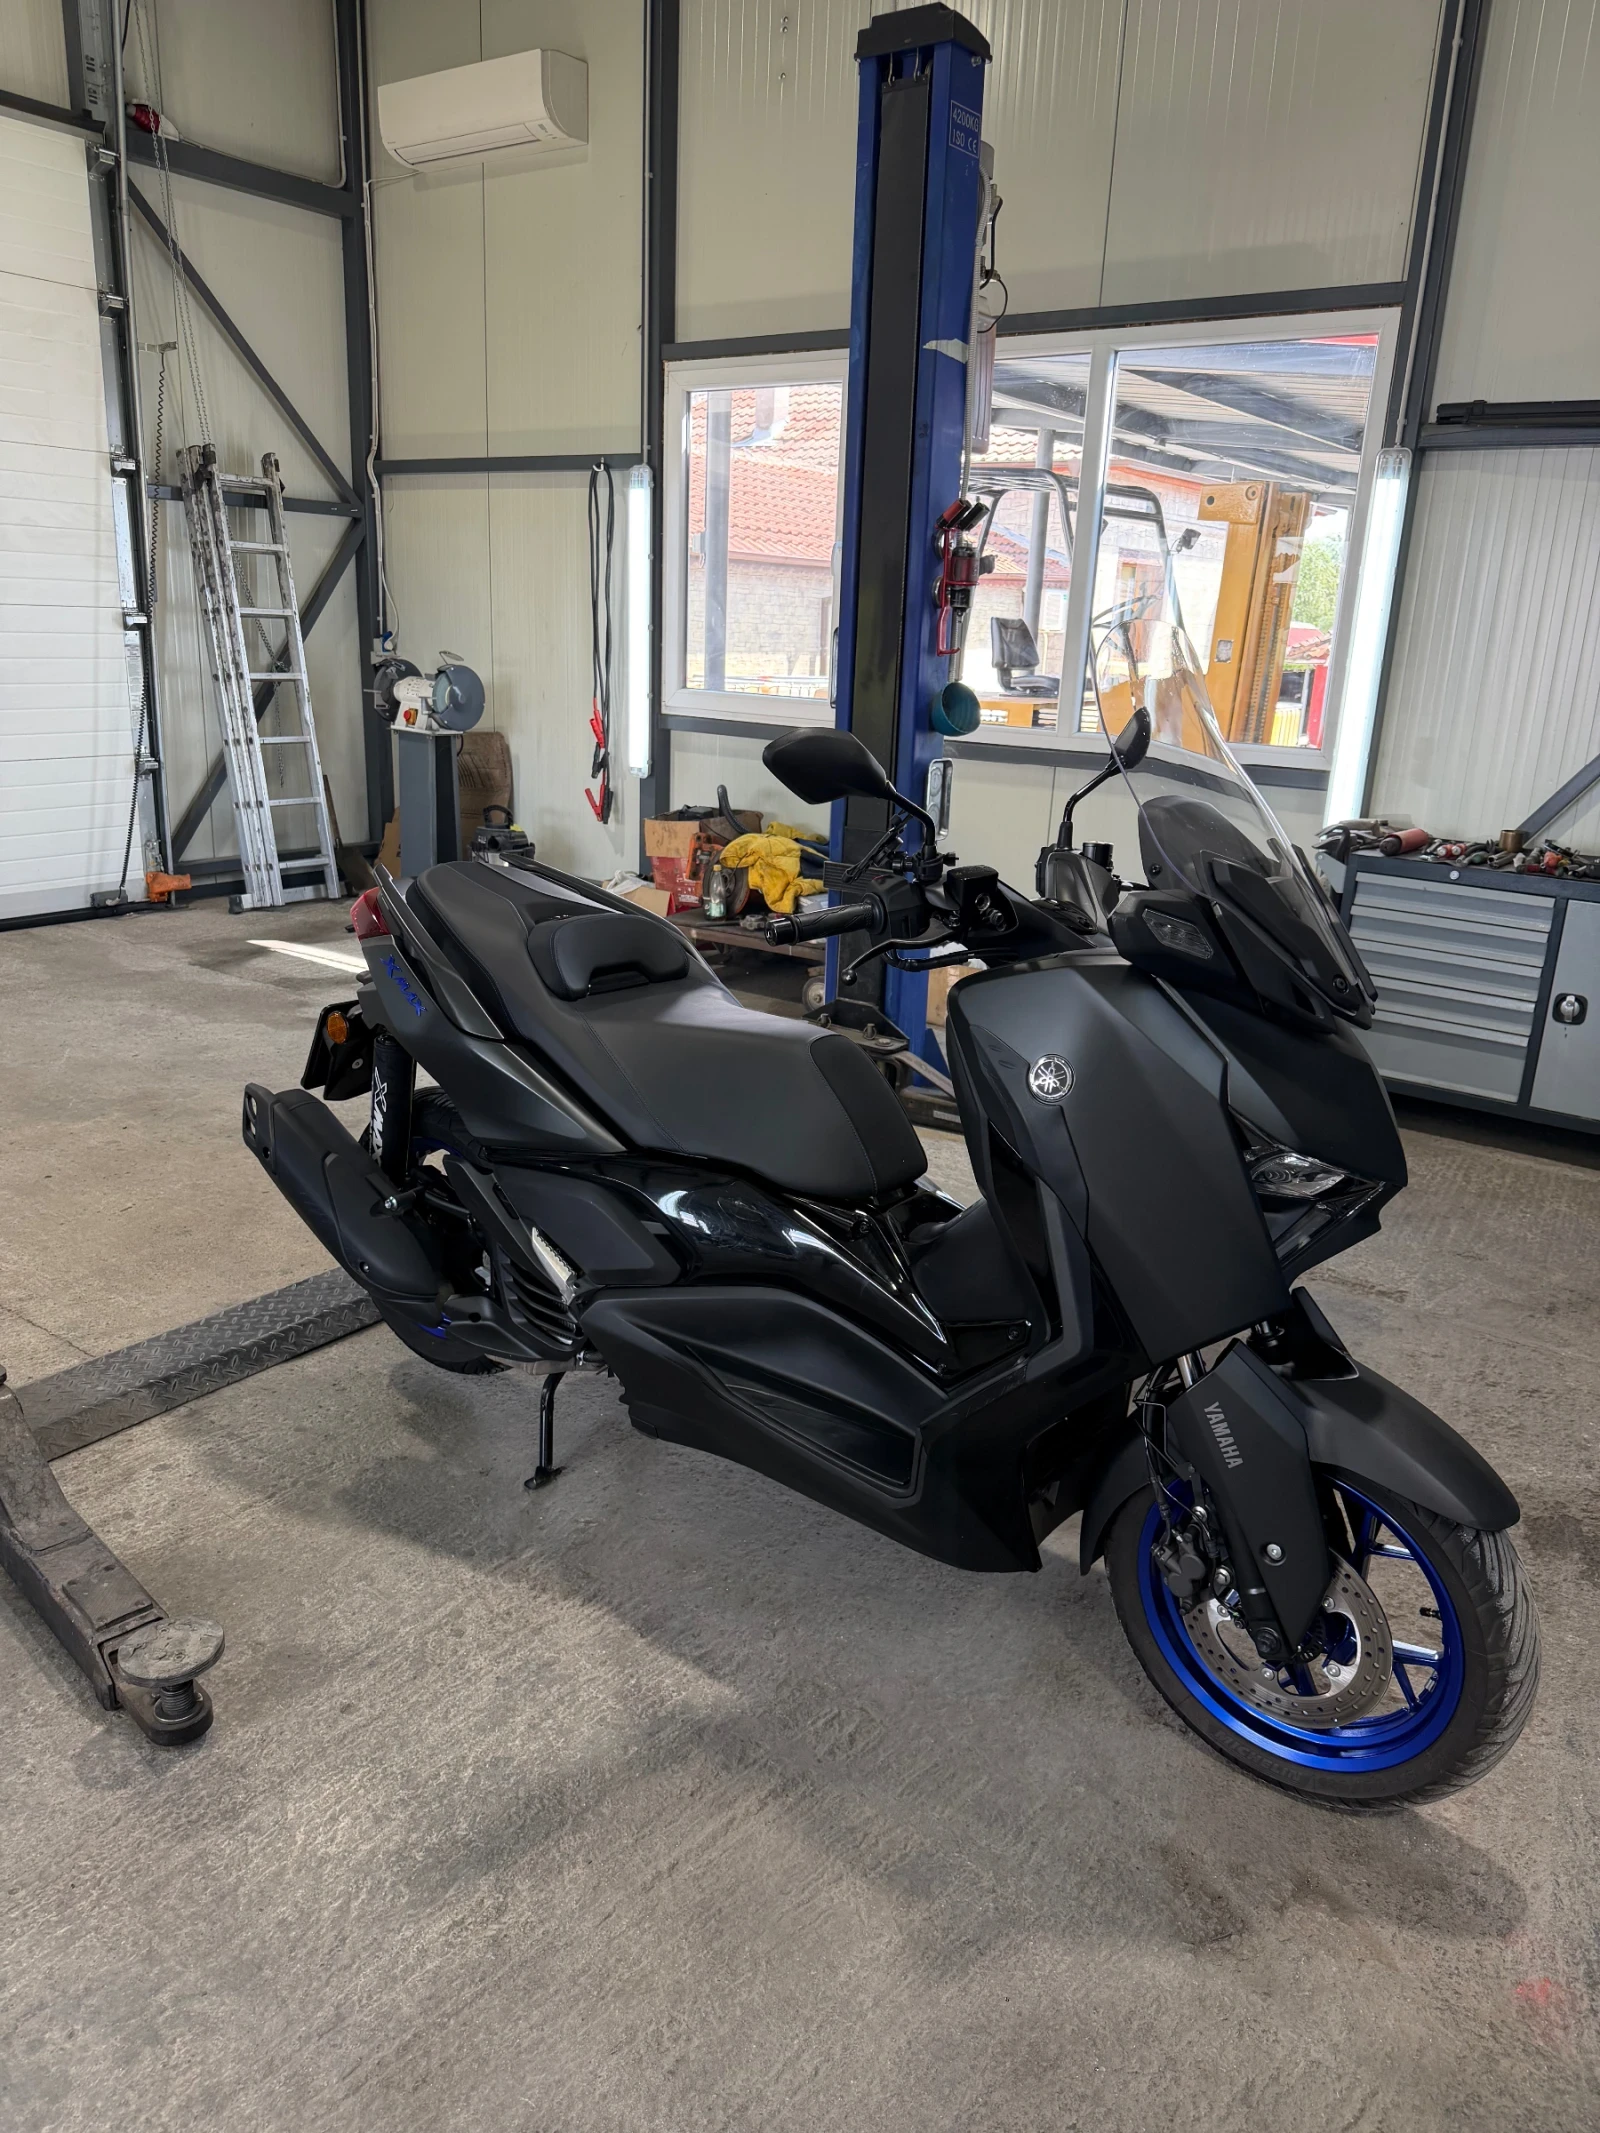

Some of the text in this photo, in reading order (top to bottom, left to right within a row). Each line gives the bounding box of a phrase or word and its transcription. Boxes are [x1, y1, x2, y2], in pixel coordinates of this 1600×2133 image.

[952, 107, 979, 133] 4200KG
[952, 129, 966, 148] ISO
[1203, 1400, 1244, 1469] YAMAHA
[1213, 1730, 1303, 1782] MICHELIN
